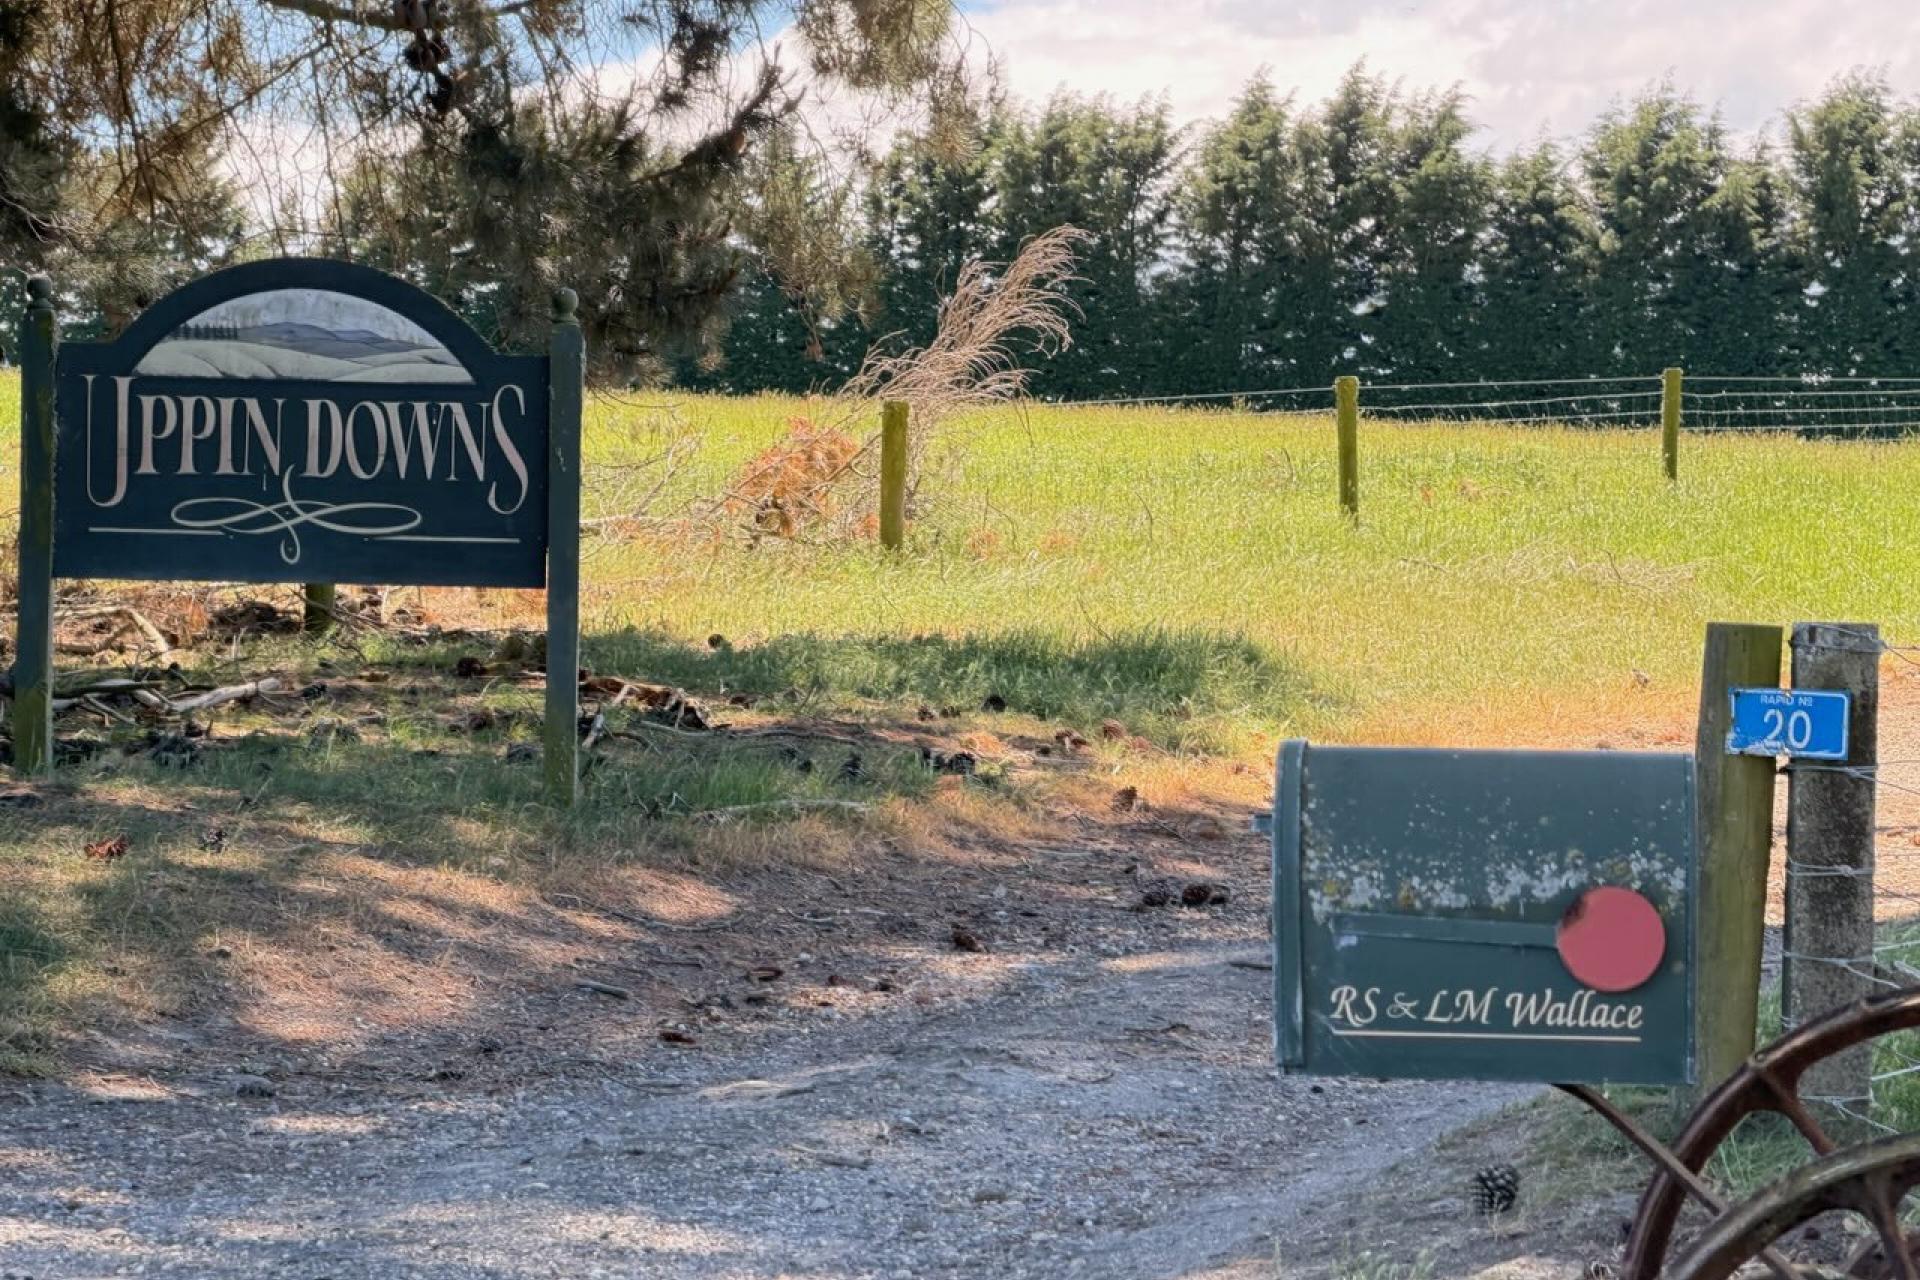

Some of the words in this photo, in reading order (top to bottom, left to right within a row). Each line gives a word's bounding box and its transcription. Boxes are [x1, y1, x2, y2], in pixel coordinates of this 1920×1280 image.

[84, 375, 284, 507] UPPIN
[302, 384, 530, 514] DOWNS
[1760, 694, 1794, 705] RAPID
[1763, 708, 1812, 749] 20
[1330, 985, 1381, 1027] RS
[1386, 992, 1419, 1019] &
[1424, 987, 1499, 1025] LM
[1505, 988, 1644, 1029] Wallace
